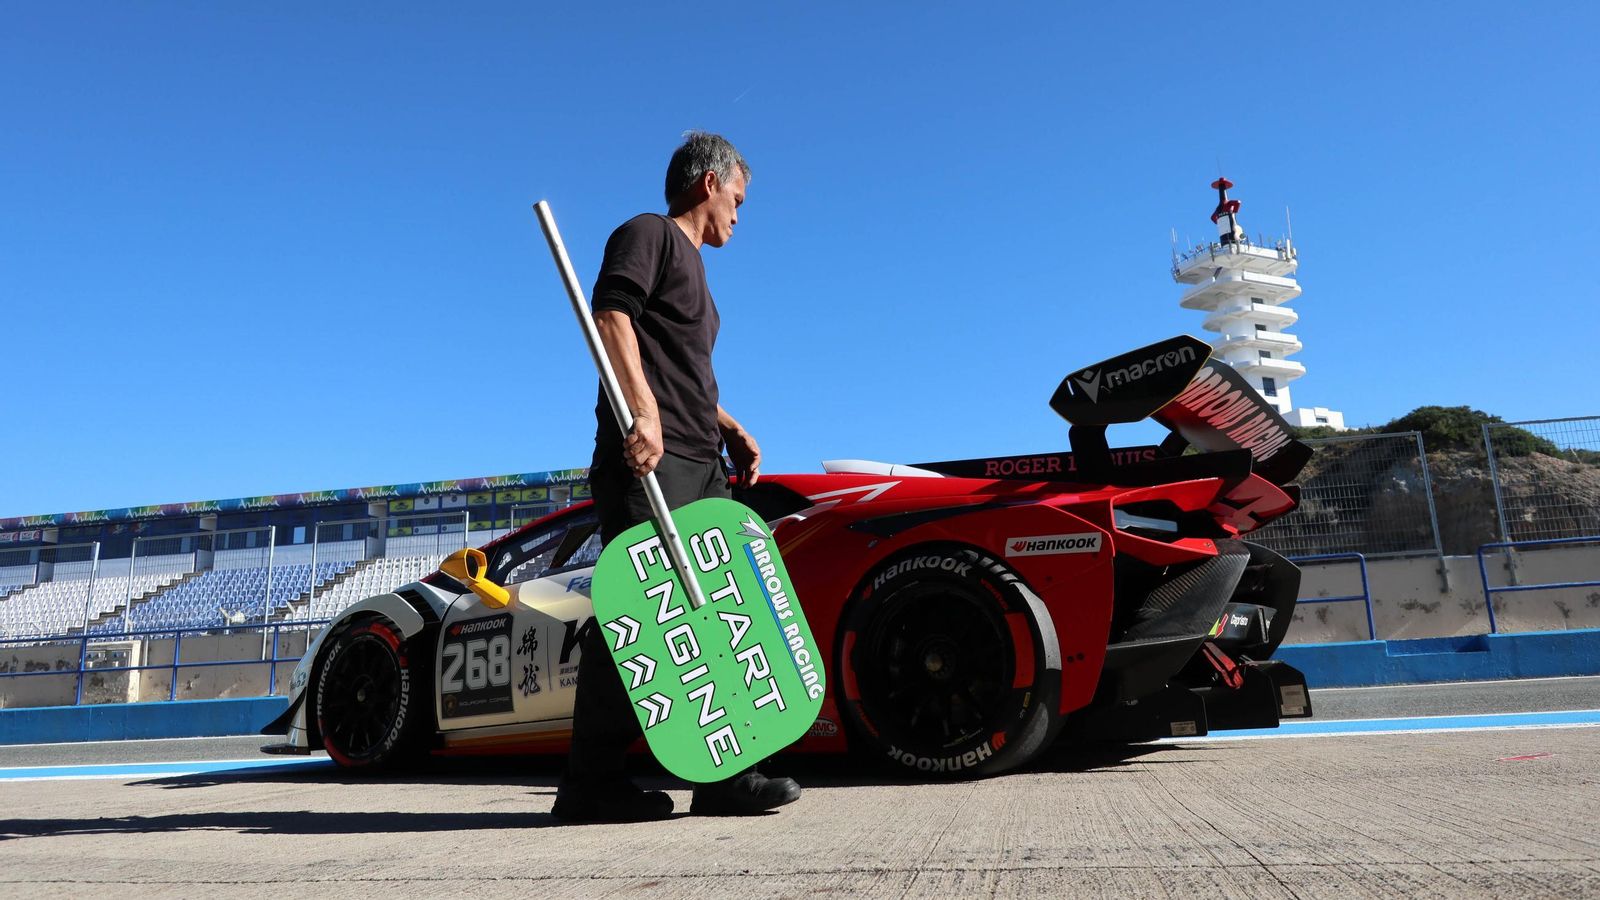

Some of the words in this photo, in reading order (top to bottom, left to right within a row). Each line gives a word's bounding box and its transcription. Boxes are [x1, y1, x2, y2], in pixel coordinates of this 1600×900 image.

[1104, 345, 1197, 389] macron
[1226, 411, 1293, 463] RACING
[984, 455, 1062, 477] ROGER
[689, 527, 787, 712] START
[749, 538, 795, 620] ARROWS
[784, 622, 824, 701] RACING
[1230, 613, 1249, 627] Capristo
[441, 634, 511, 694] 268
[626, 534, 743, 768] ENGINE
